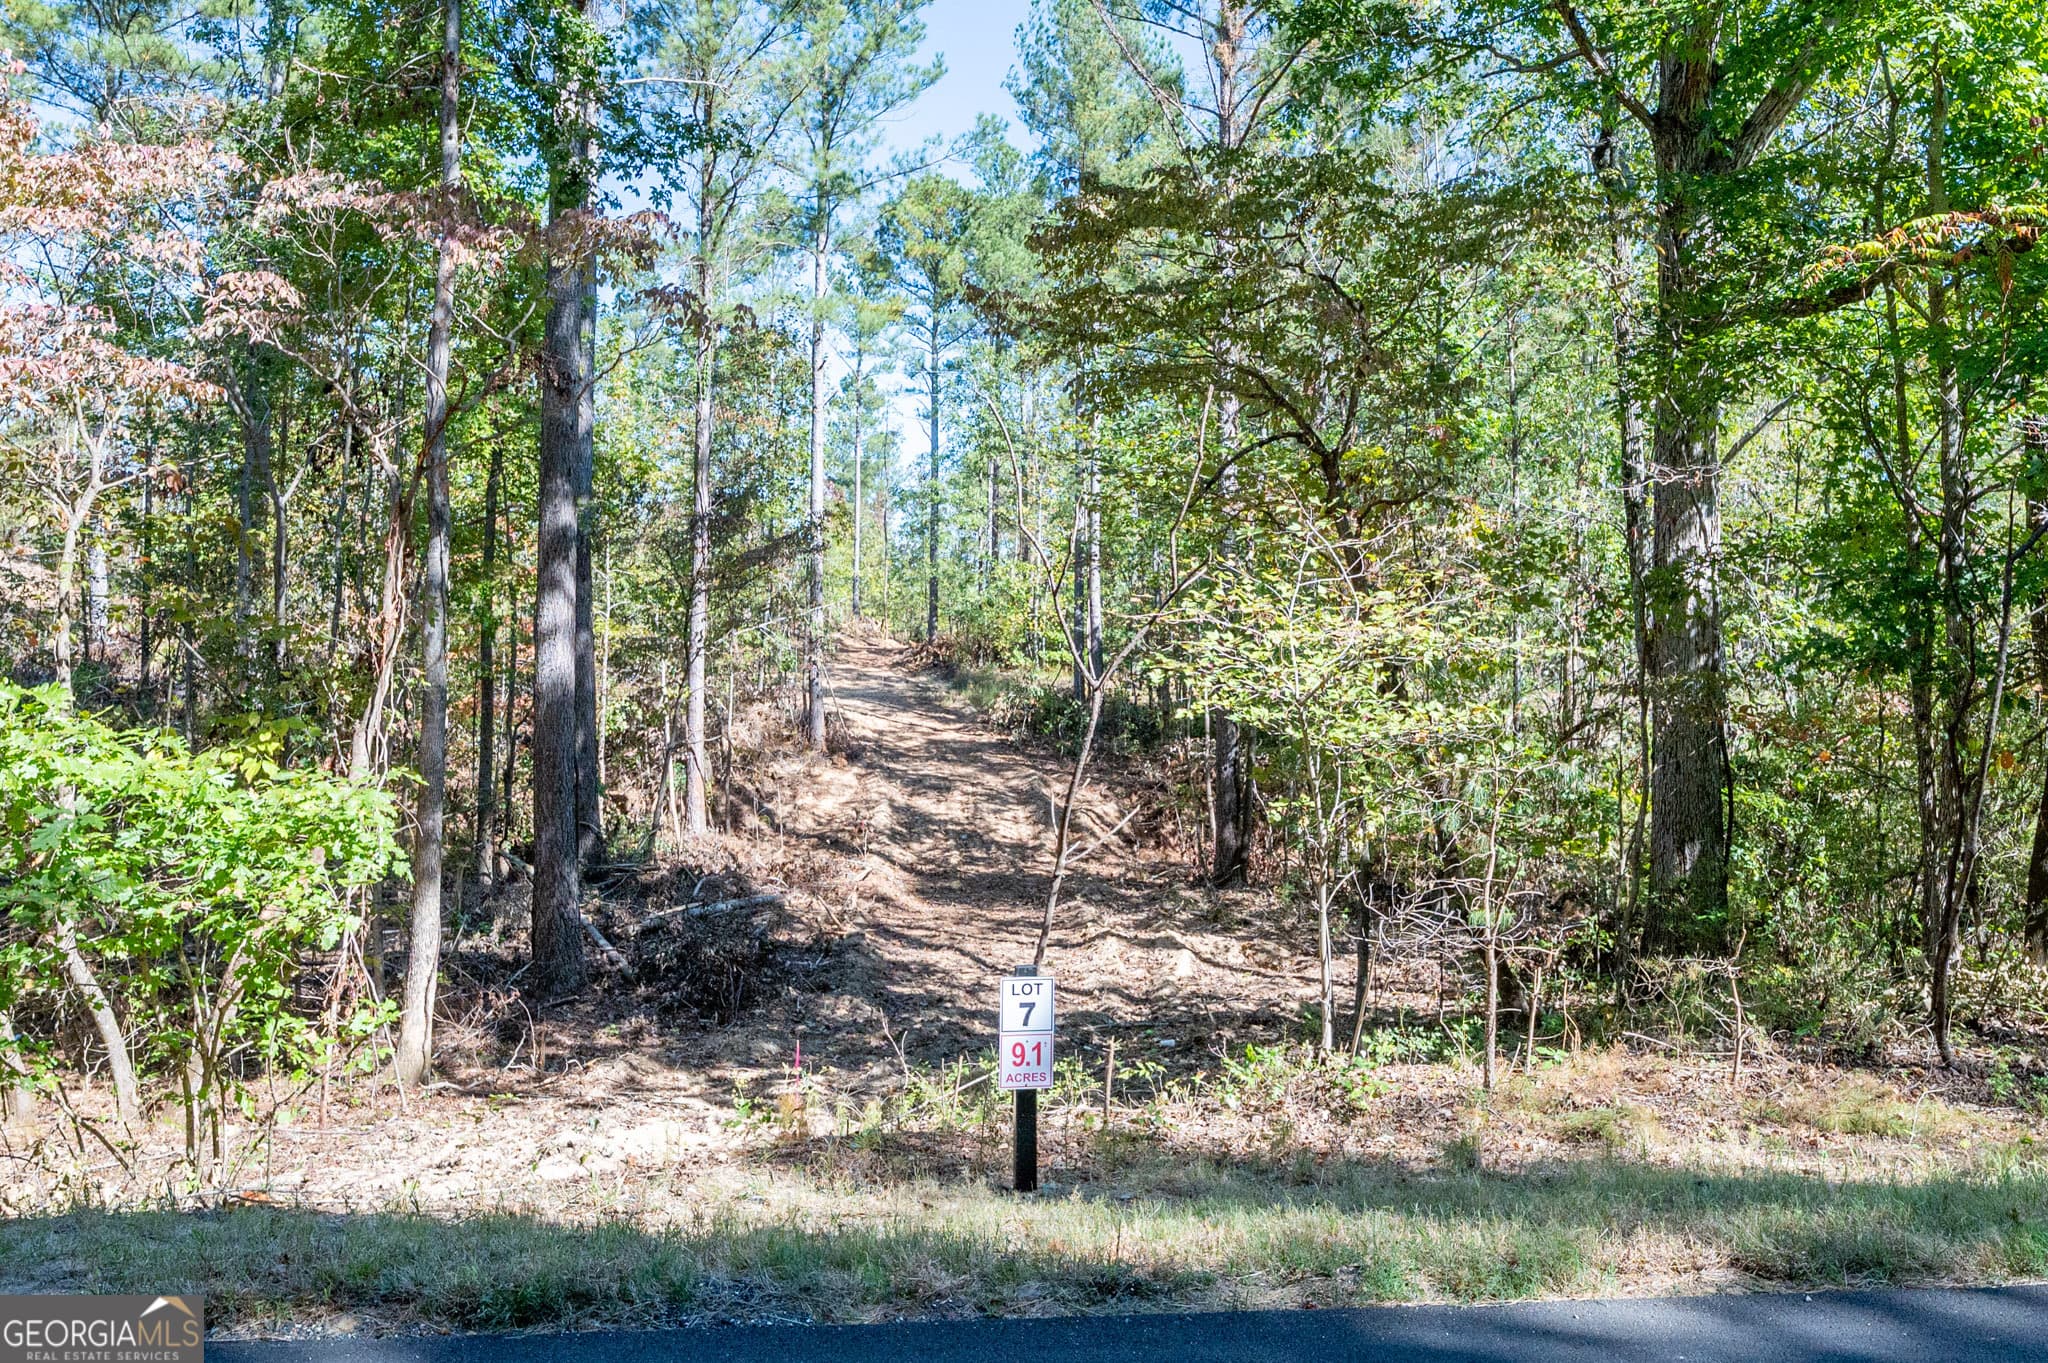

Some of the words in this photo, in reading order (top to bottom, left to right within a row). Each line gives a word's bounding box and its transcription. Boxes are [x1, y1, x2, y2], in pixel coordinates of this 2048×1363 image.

[1012, 983, 1044, 996] LOT
[1019, 1002, 1036, 1027] 7
[1011, 1041, 1042, 1067] 9.1
[1006, 1072, 1047, 1083] ACRES
